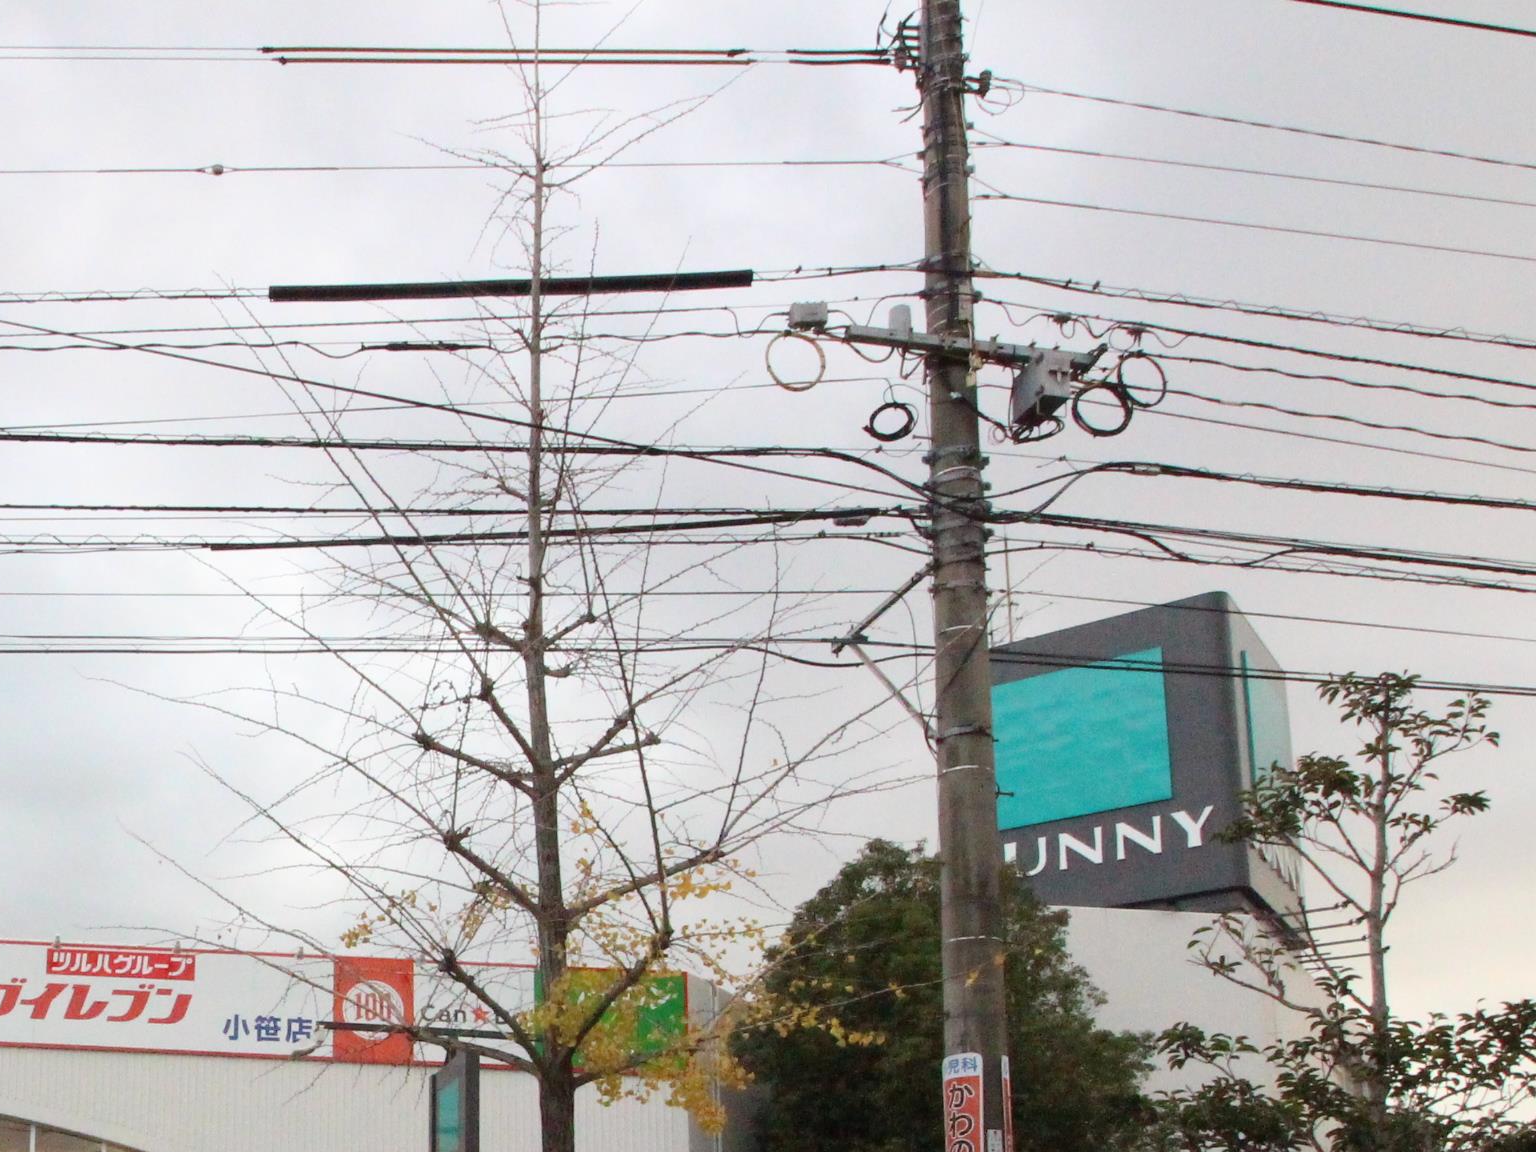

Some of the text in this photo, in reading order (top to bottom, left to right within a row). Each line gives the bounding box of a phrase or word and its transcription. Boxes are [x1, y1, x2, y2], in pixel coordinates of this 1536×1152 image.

[1004, 804, 1215, 878] UNNY
[51, 951, 194, 978] ツルハグループ
[222, 1013, 312, 1044] 小笹店
